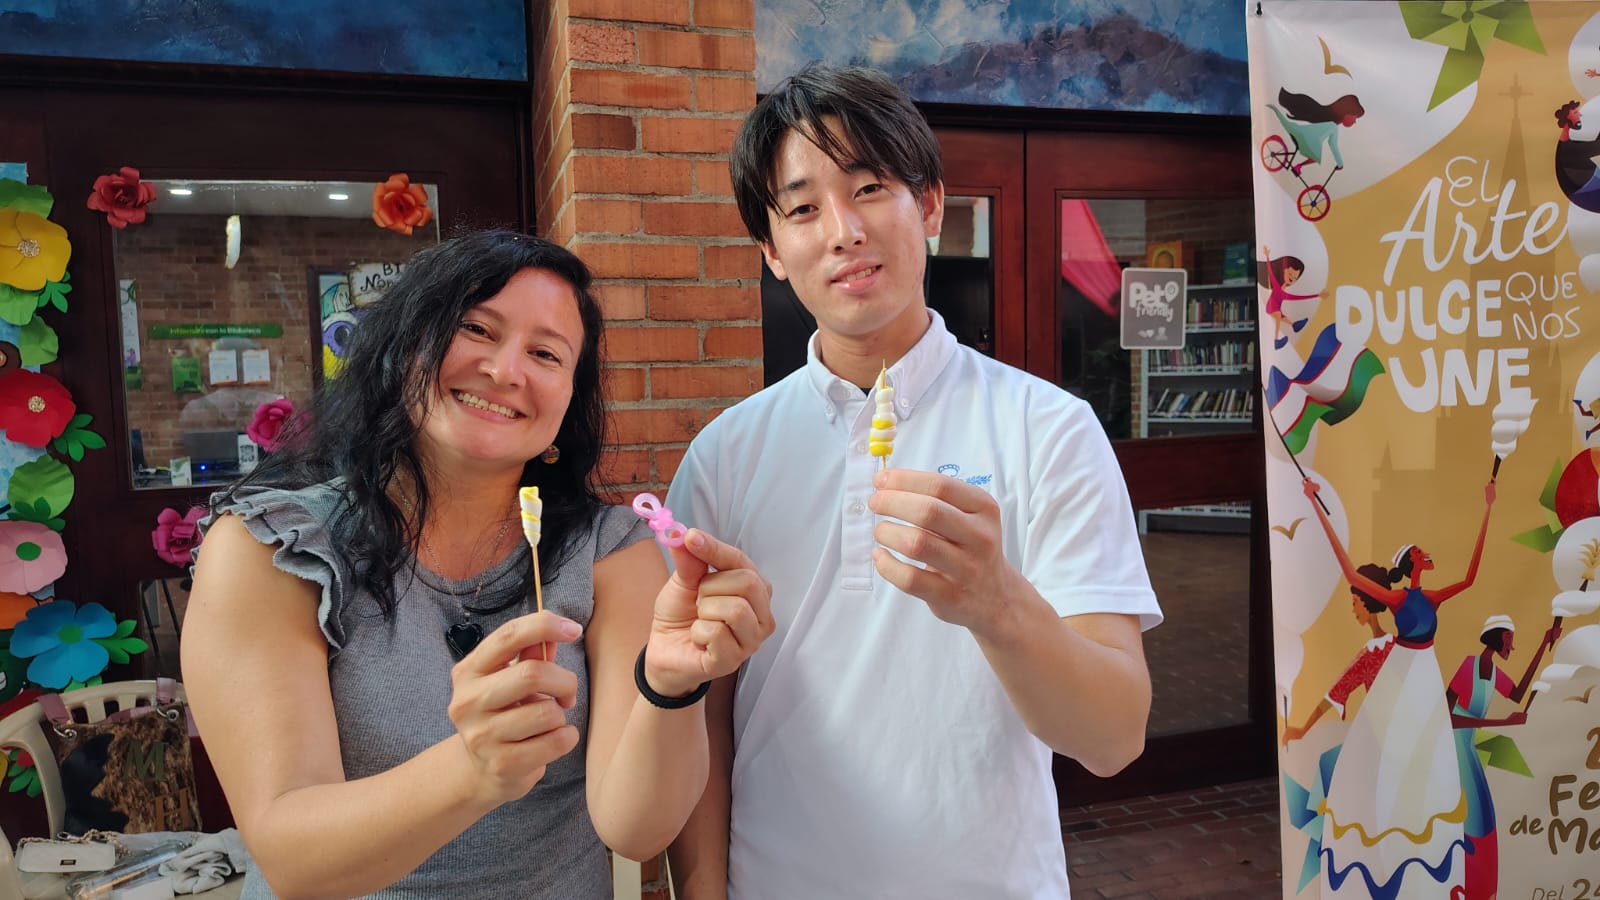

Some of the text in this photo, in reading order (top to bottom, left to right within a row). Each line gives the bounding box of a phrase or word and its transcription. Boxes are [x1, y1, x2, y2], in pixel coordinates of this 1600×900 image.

[1379, 176, 1569, 287] Arte
[1129, 281, 1165, 308] Pet
[1505, 272, 1577, 305] QUE
[1136, 300, 1173, 322] friendly
[1335, 279, 1502, 345] DULCE
[1512, 306, 1581, 341] NOS
[1388, 347, 1533, 413] UNE
[1509, 814, 1544, 836] de
